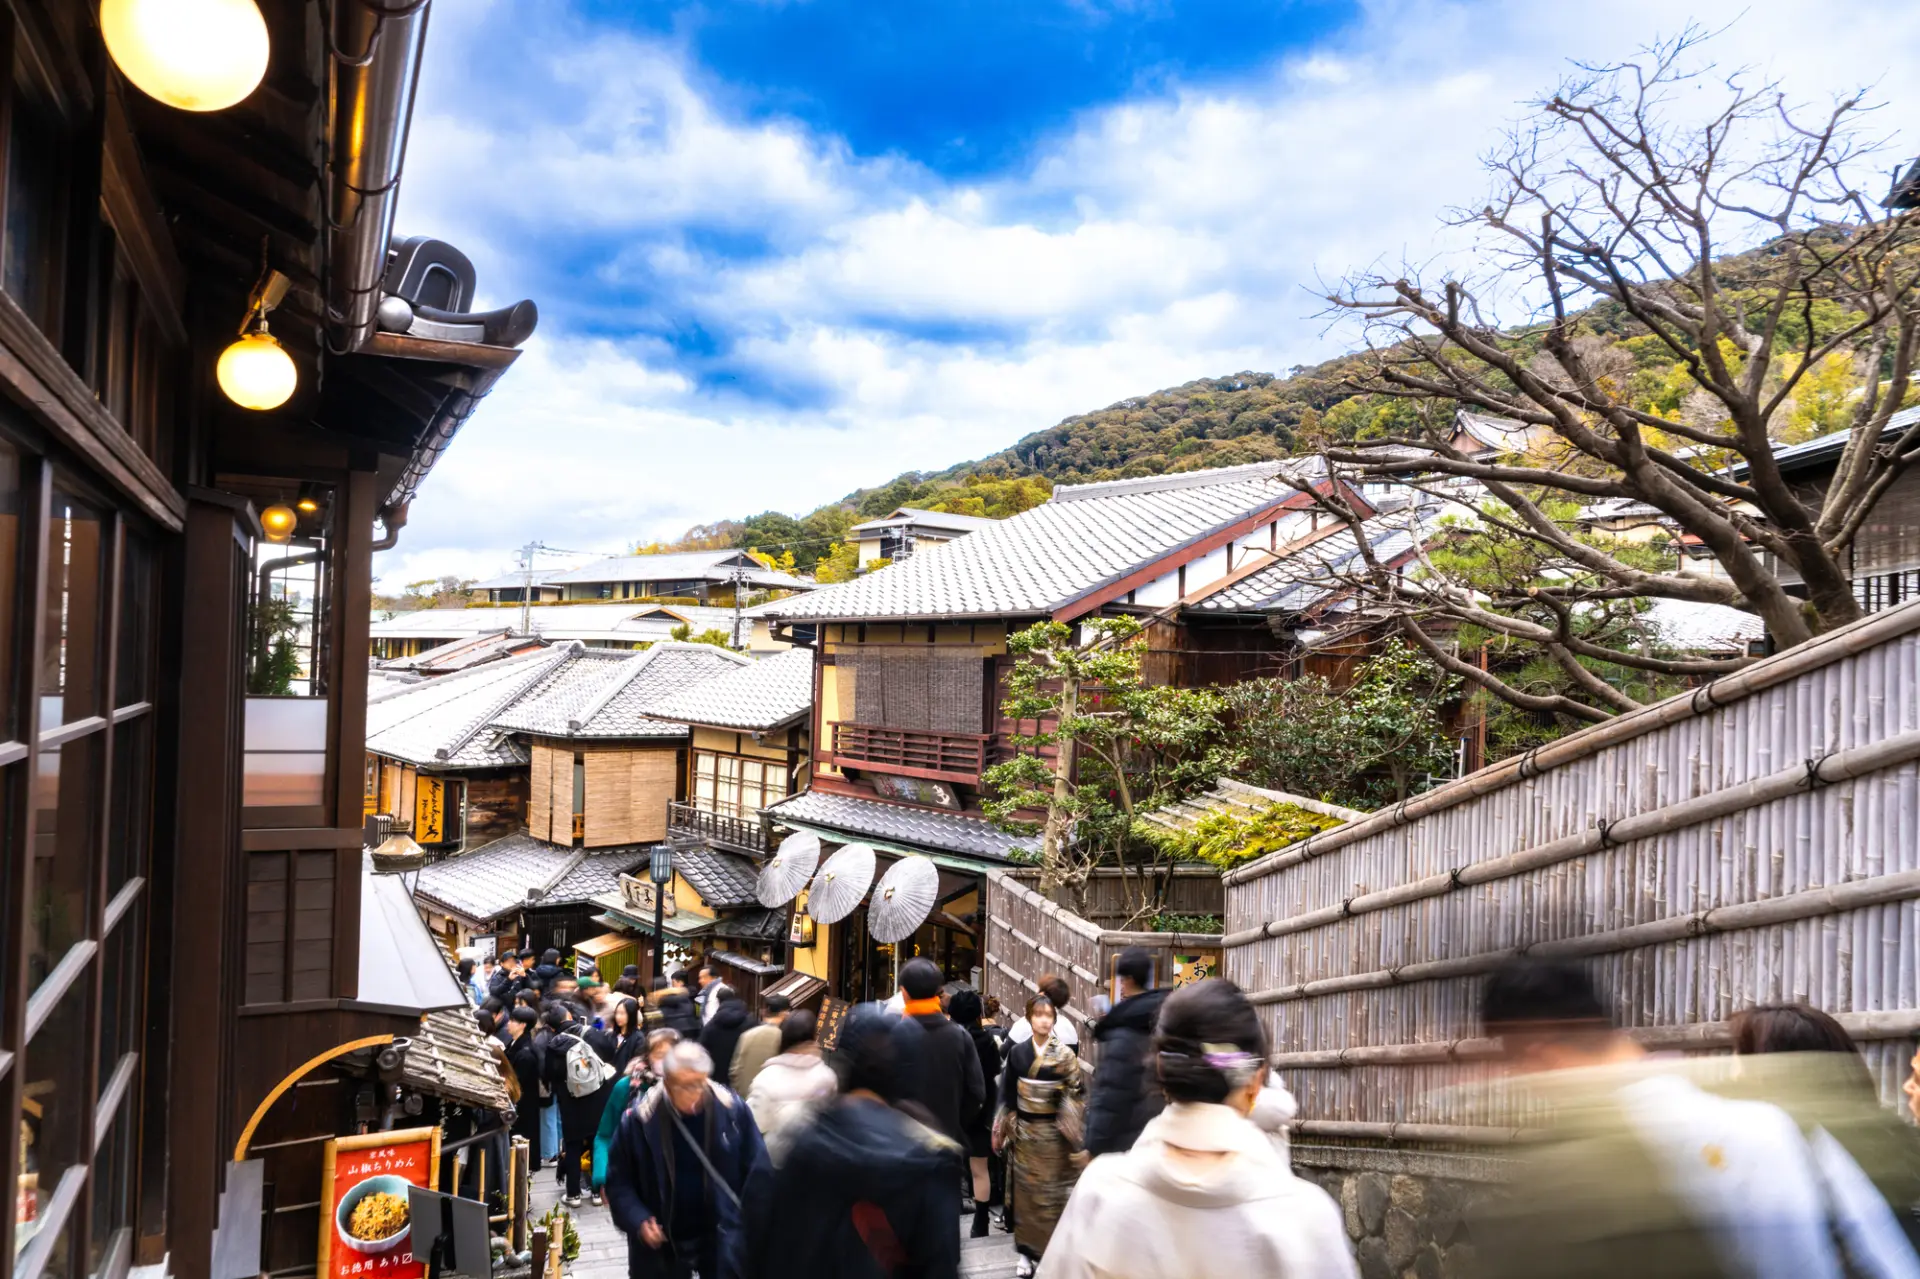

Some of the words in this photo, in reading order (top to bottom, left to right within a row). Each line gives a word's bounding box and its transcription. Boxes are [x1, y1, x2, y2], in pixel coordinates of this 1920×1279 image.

[348, 1157, 415, 1175] 山椒ちりめん
